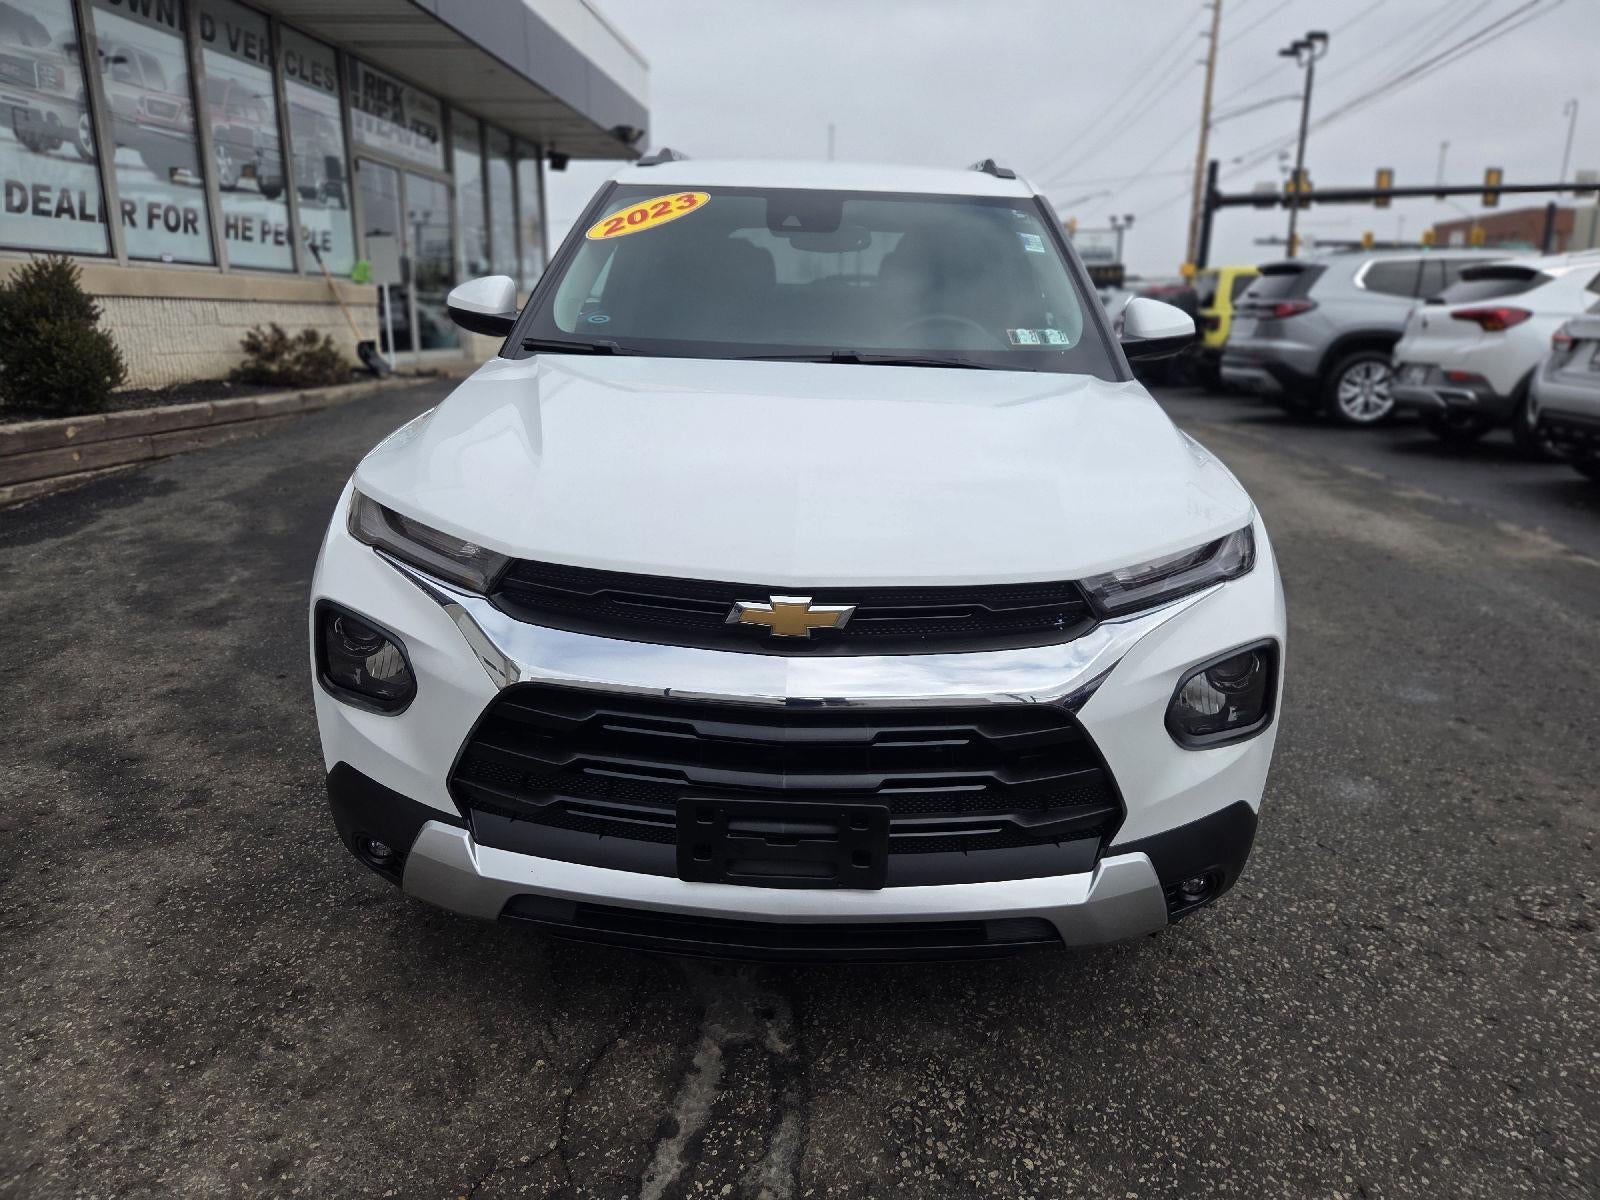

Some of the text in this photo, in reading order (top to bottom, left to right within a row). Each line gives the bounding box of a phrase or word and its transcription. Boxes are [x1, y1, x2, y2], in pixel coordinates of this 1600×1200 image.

[111, 0, 335, 92] WND VEHCLES
[147, 200, 199, 236] FOR
[224, 213, 254, 242] HE
[603, 194, 698, 236] 2023
